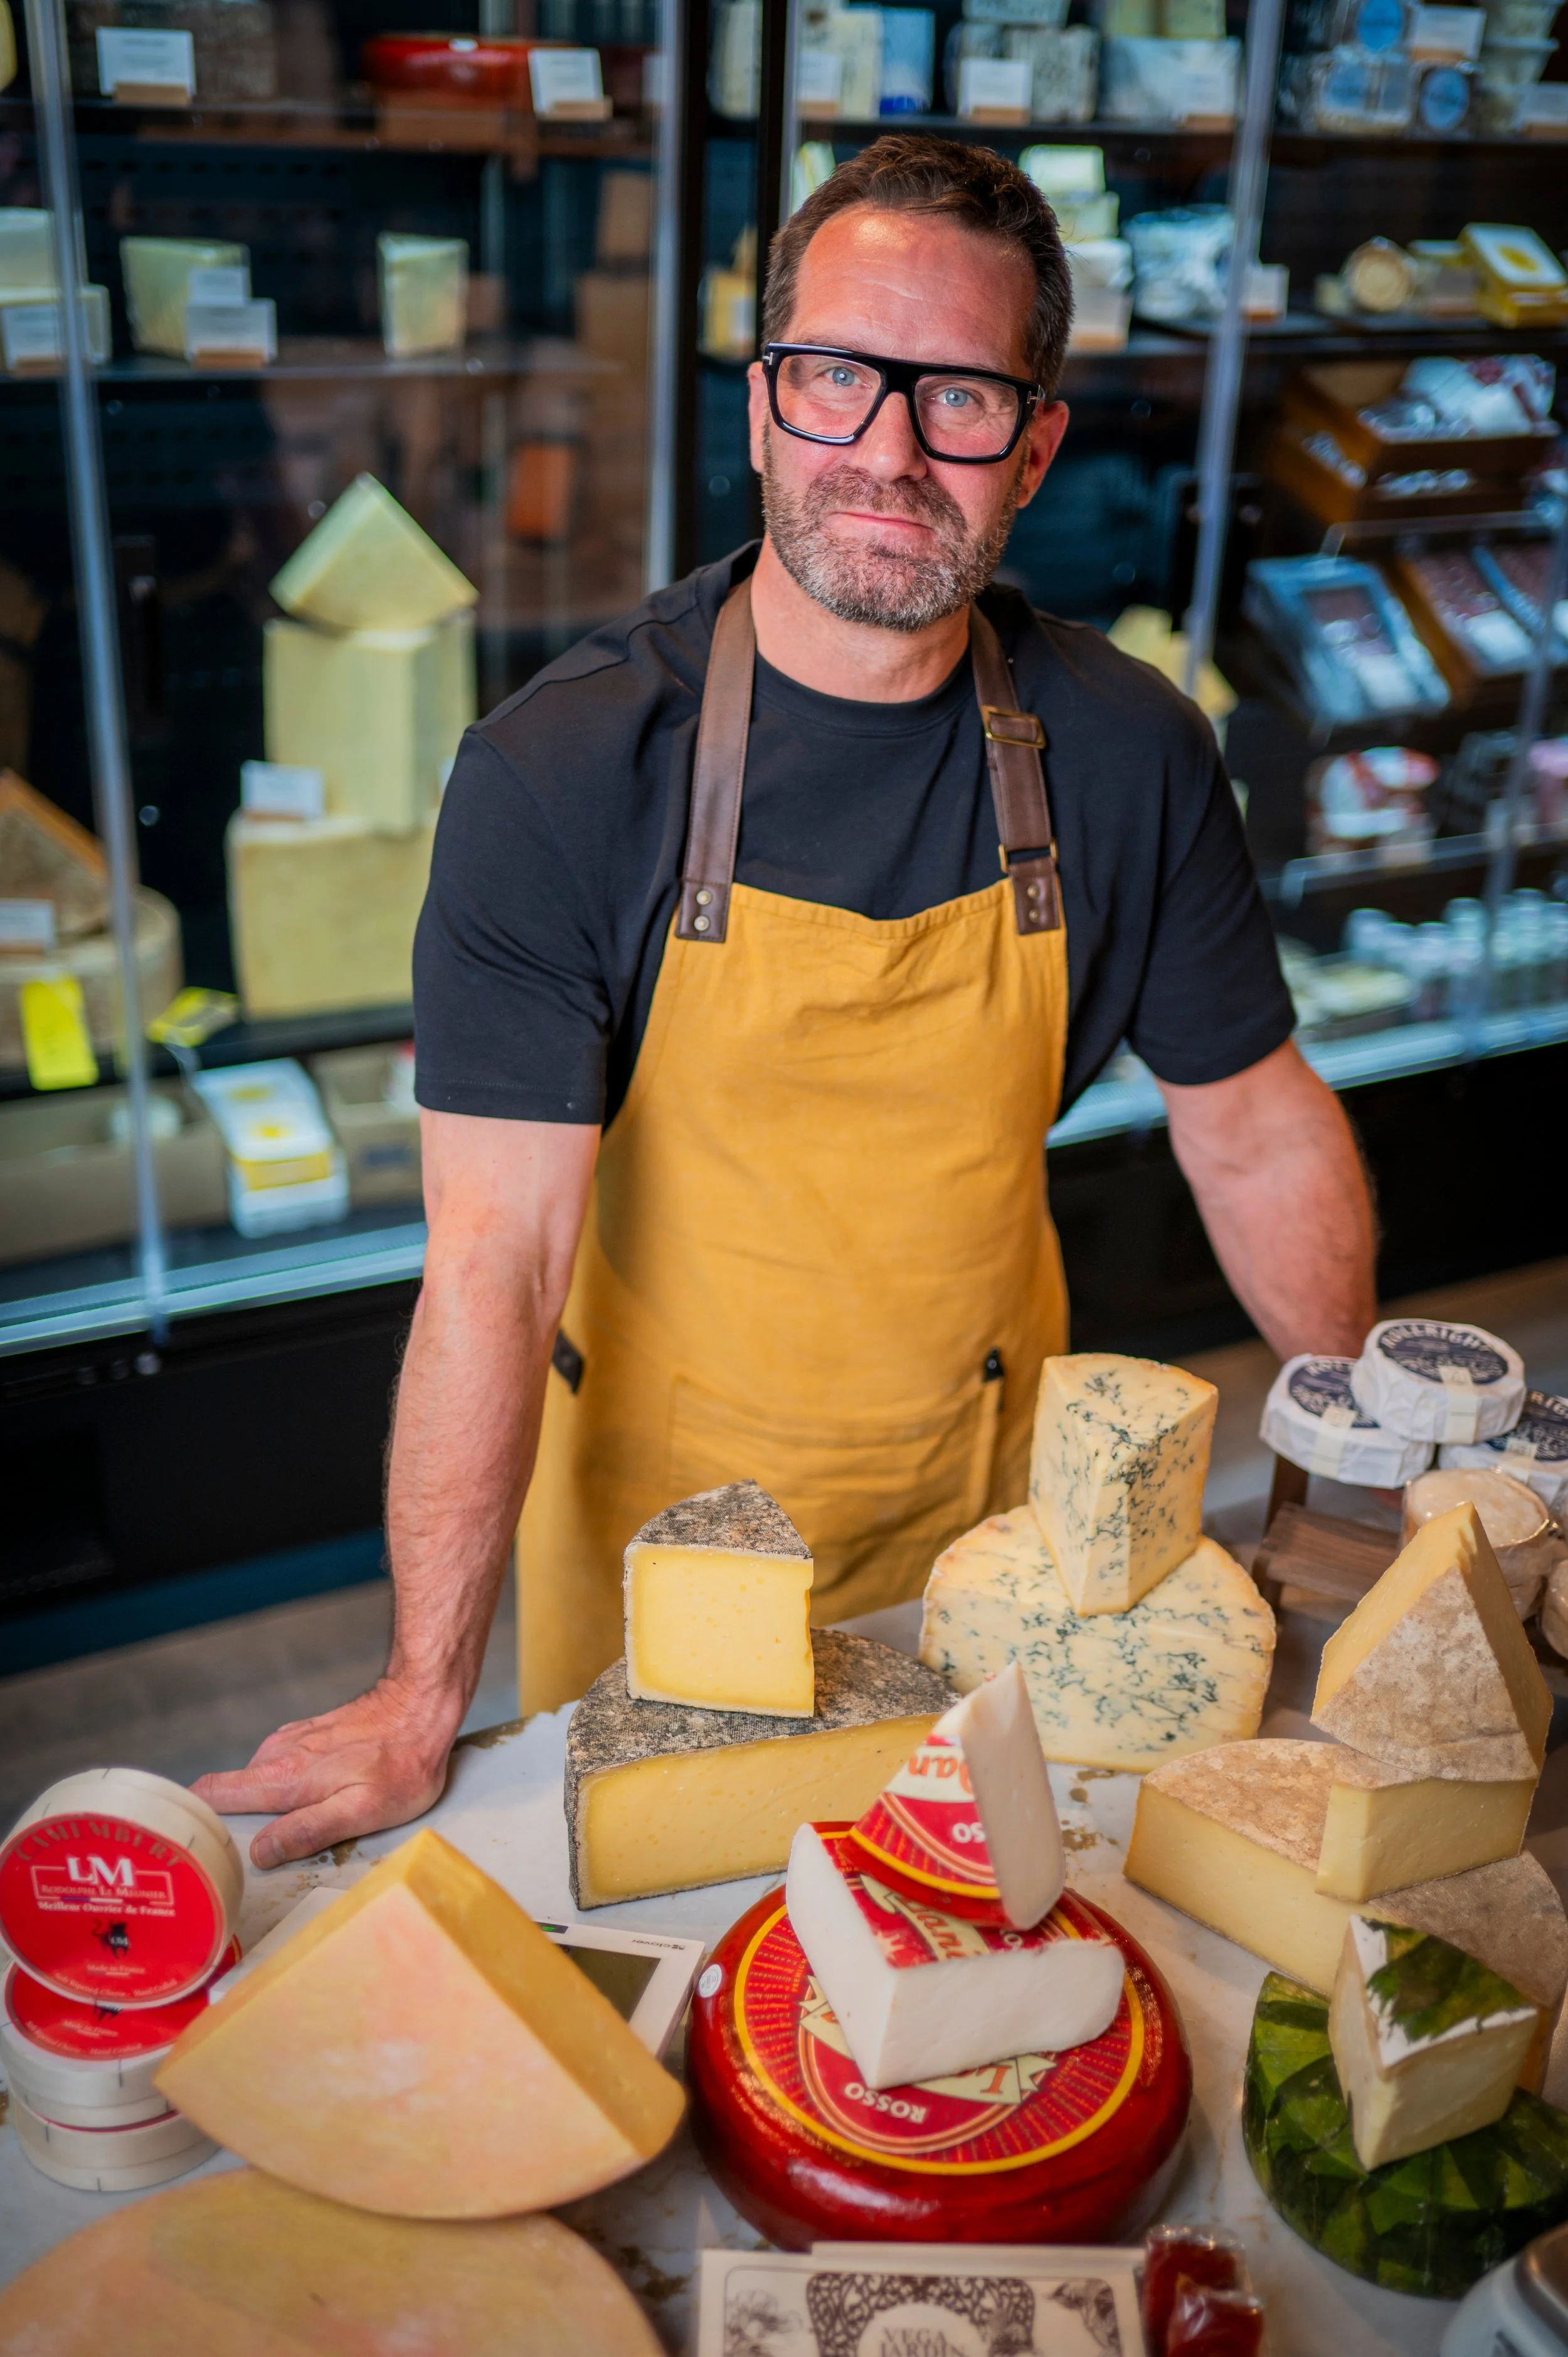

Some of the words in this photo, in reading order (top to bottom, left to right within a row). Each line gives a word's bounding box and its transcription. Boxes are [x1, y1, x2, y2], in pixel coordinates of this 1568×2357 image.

[66, 1854, 135, 1886] LM
[38, 1901, 81, 1911] Meilleur
[83, 1903, 123, 1913] Ouvrier
[127, 1905, 138, 1915] de
[140, 1906, 176, 1917] France
[632, 1939, 670, 1947] clover
[119, 1965, 145, 1973] France
[845, 2082, 927, 2124] ROSSO
[882, 2328, 947, 2345] VEGA
